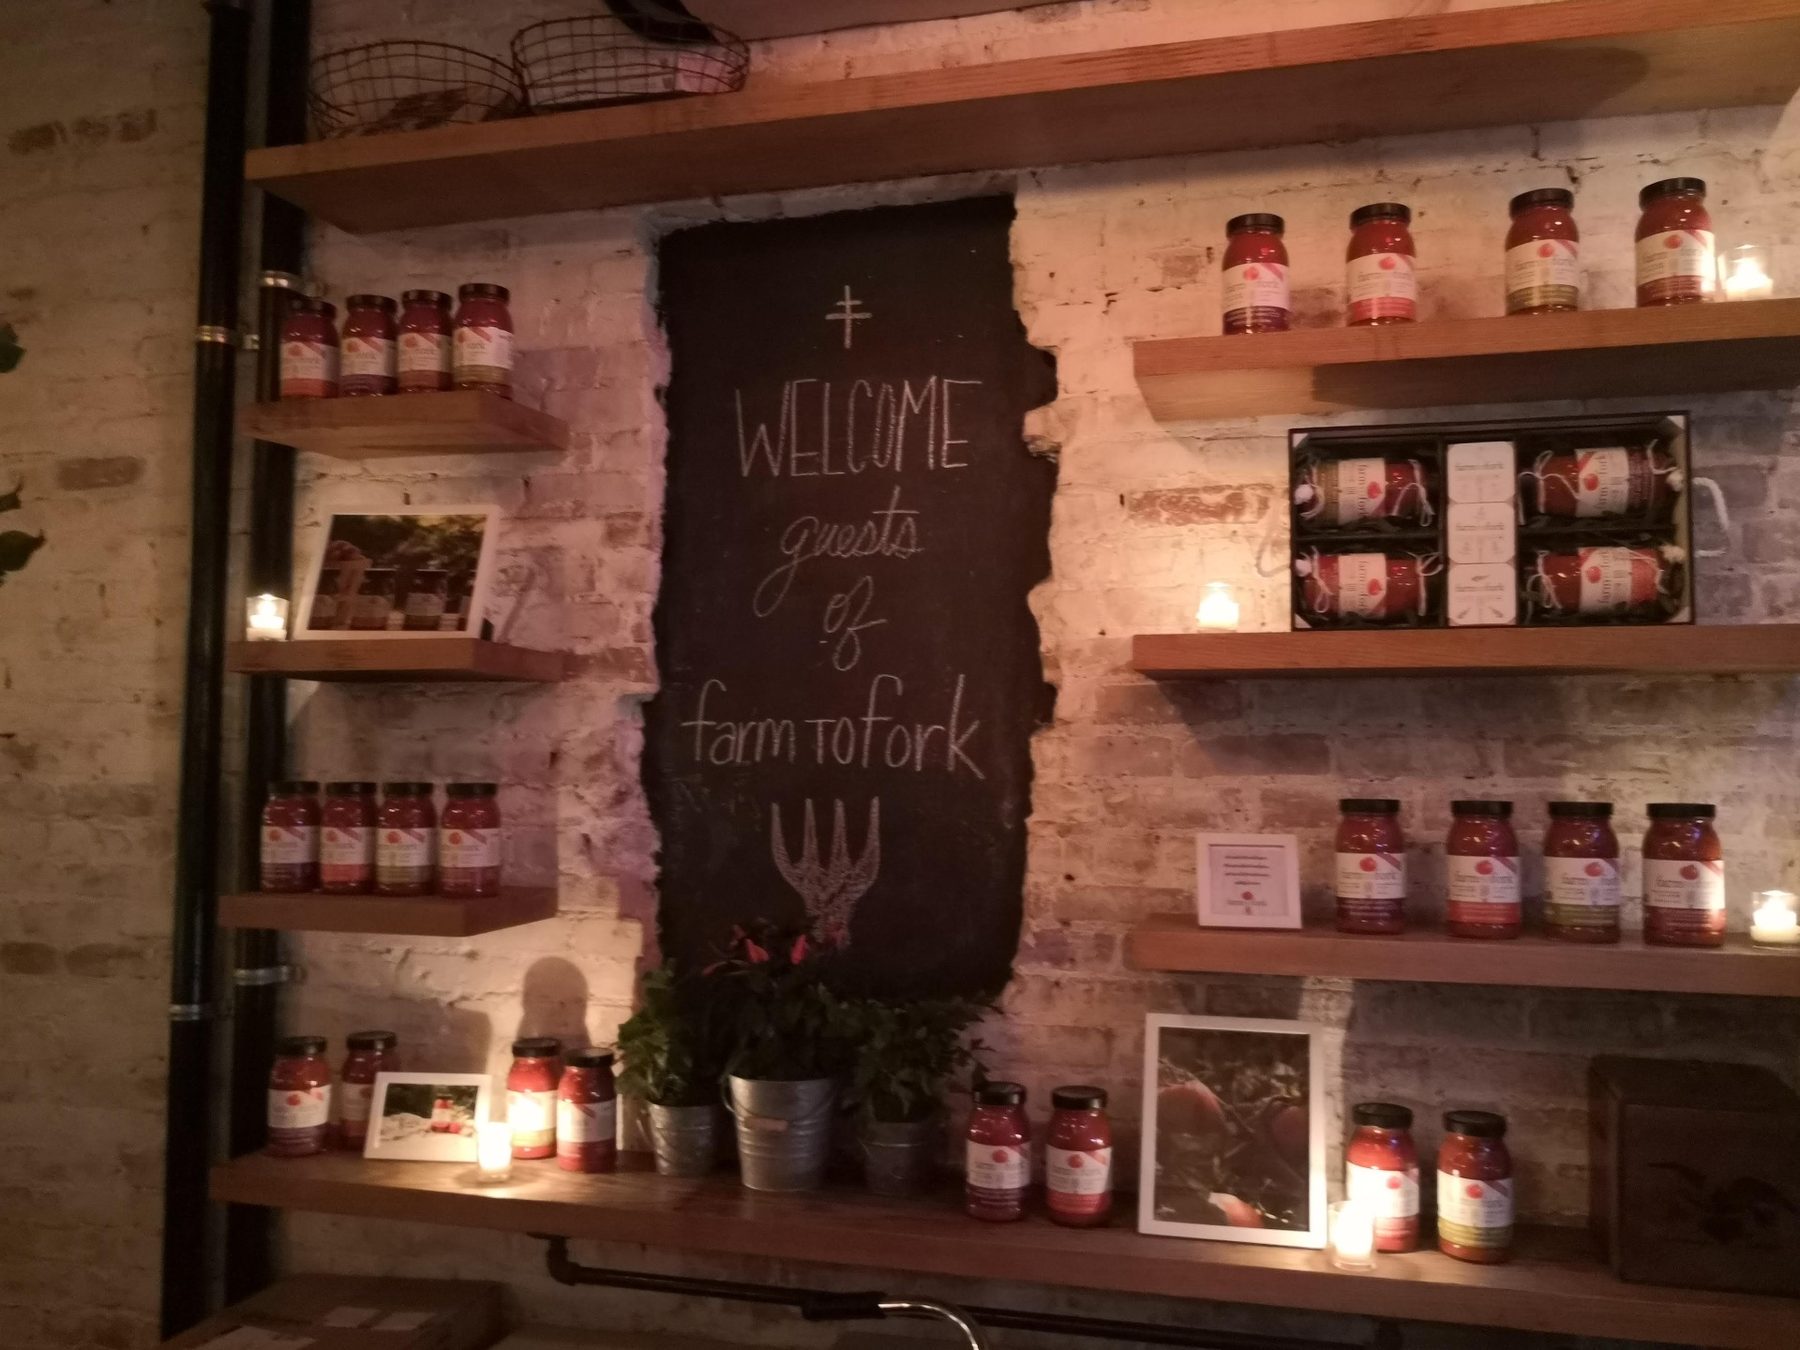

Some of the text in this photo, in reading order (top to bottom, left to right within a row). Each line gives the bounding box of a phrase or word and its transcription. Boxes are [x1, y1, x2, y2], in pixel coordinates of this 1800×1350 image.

[736, 375, 983, 477] WELCOME
[753, 485, 925, 618] guests
[823, 574, 888, 671] of
[680, 678, 796, 766] farm
[861, 672, 986, 780] fork
